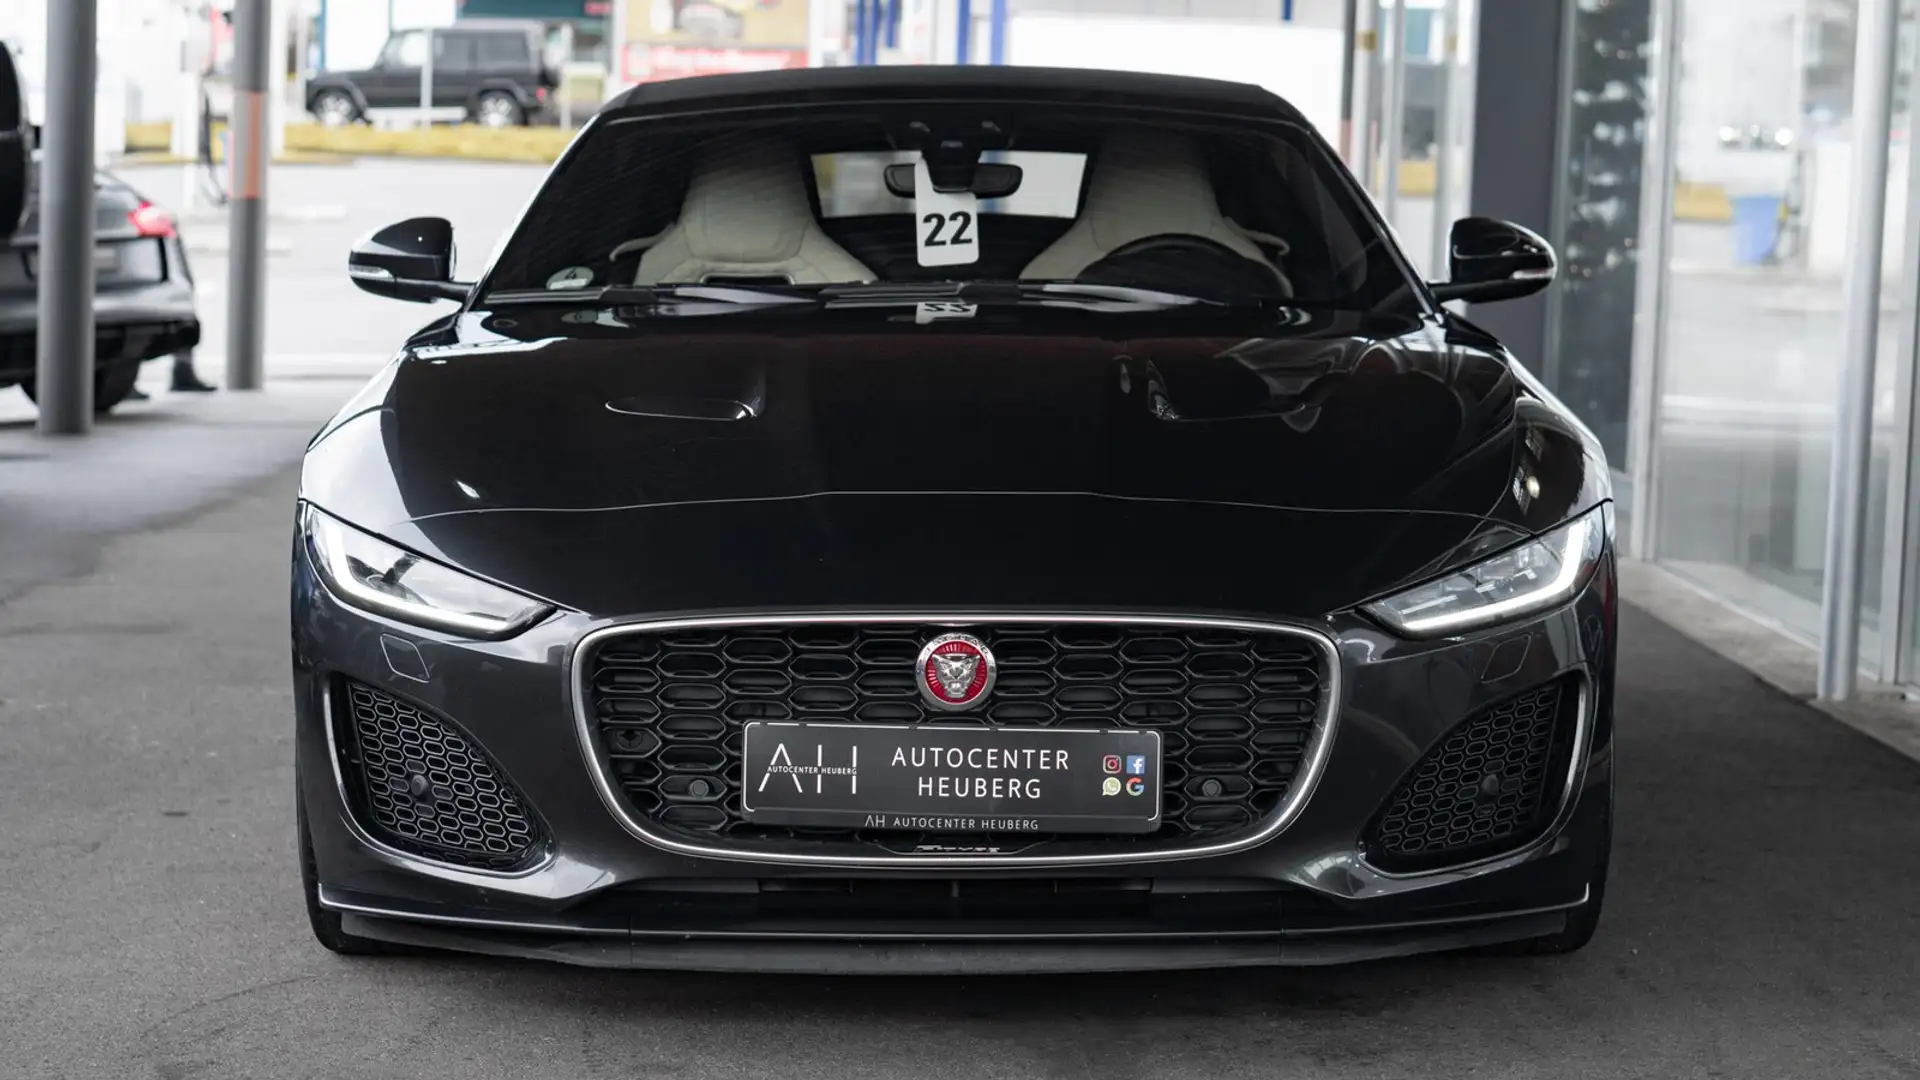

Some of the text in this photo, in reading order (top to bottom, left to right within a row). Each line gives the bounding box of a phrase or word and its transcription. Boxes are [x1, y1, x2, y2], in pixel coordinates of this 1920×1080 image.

[922, 211, 973, 247] 22
[758, 743, 857, 794] AH
[891, 747, 1069, 770] AUTOCENTER
[821, 767, 857, 775] HEUBERG
[918, 777, 1041, 798] HEUBERG
[893, 817, 975, 829] AUTOCENTER
[981, 820, 1038, 830] HEUBERG
